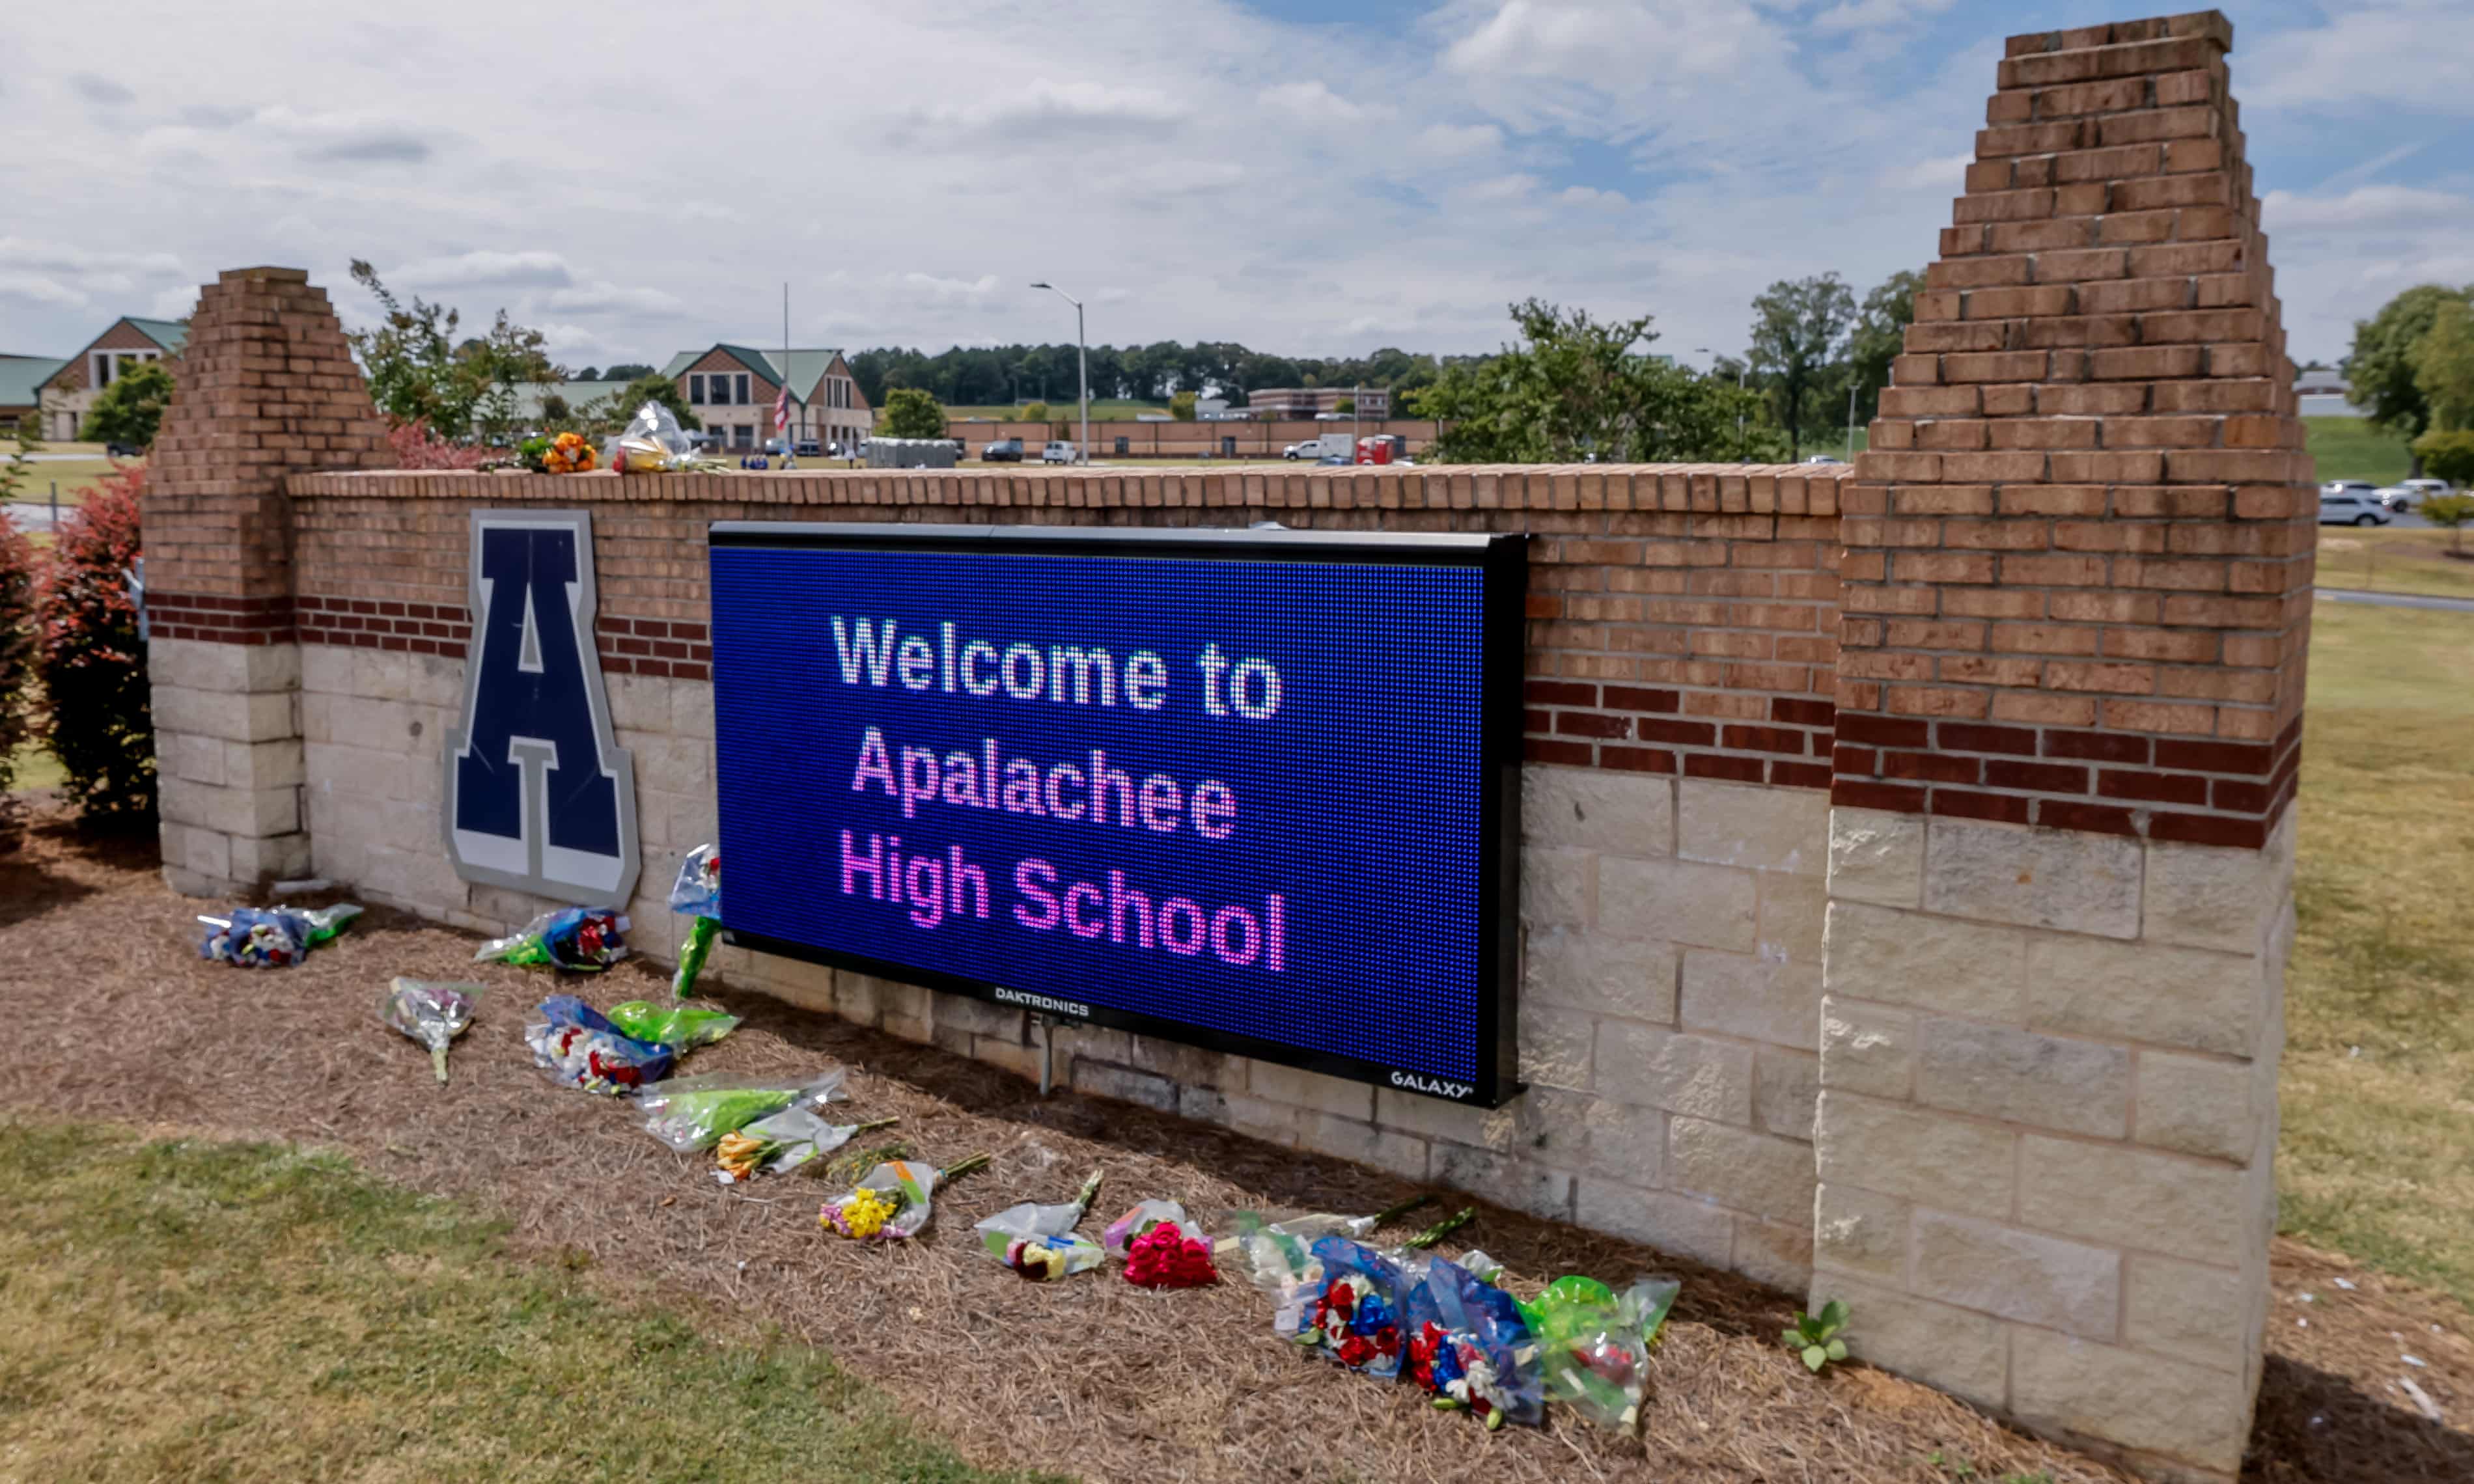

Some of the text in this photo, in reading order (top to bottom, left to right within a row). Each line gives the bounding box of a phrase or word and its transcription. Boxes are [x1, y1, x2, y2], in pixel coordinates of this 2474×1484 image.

[451, 519, 625, 892] A
[831, 615, 1283, 721] Welcome to
[852, 726, 1238, 840] Apalachee
[839, 829, 1286, 972] High School
[995, 987, 1089, 1017] DAKTRONICS
